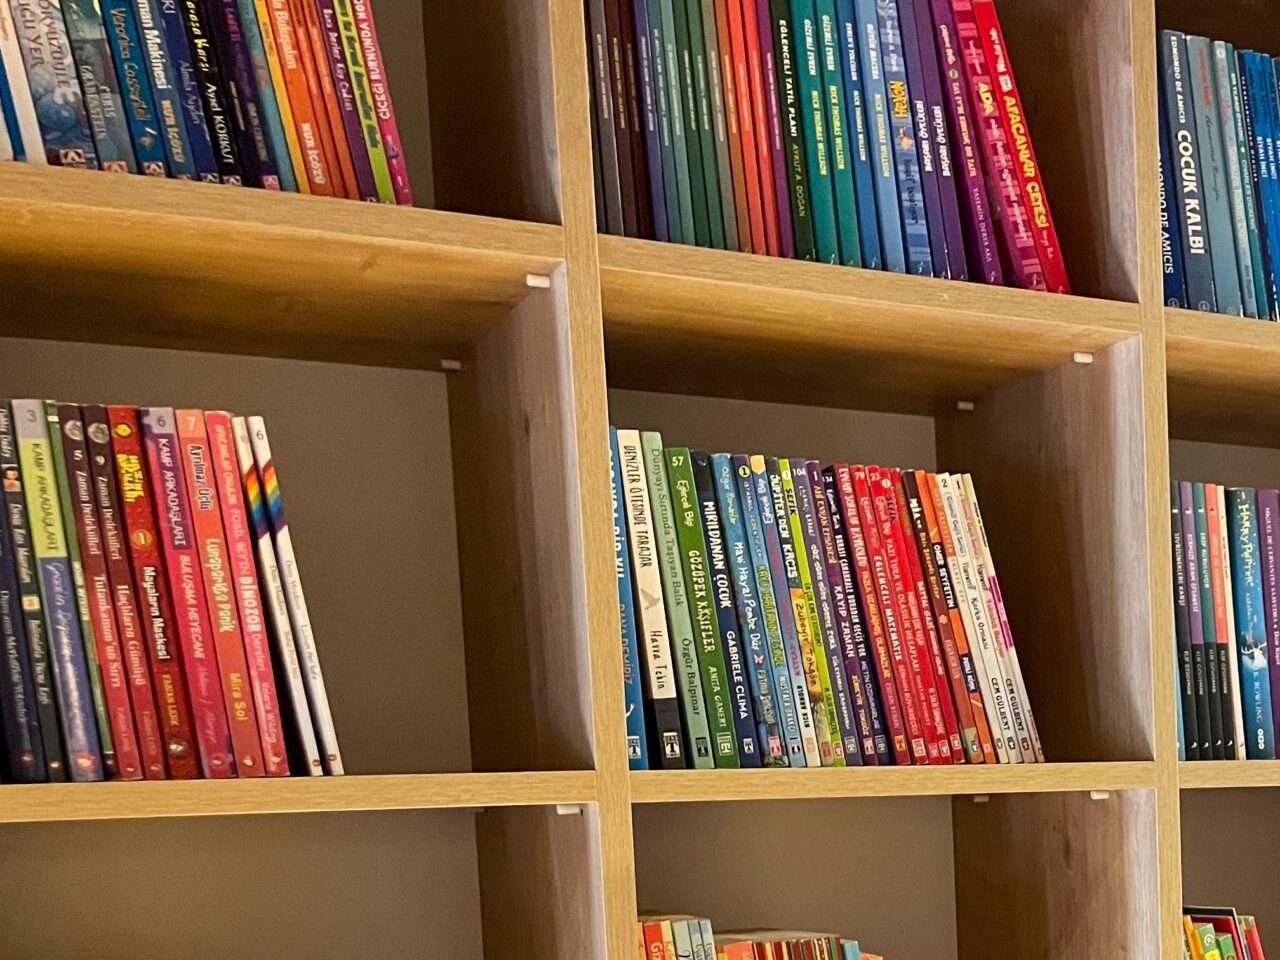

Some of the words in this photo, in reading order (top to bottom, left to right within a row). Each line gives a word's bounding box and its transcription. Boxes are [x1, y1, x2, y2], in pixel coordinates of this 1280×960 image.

[136, 0, 156, 27] man
[111, 8, 135, 58] Veronica
[143, 30, 171, 89] Makinesi
[1171, 36, 1182, 78] EDMONDO
[205, 83, 222, 111] Aysel
[784, 78, 796, 104] TATİL
[811, 90, 821, 108] NICK
[830, 86, 840, 103] NICK
[854, 90, 863, 105] NICK
[978, 82, 995, 116] ADA
[1175, 80, 1184, 92] DE
[875, 94, 885, 109] NICK
[1176, 94, 1187, 123] AMICIS
[787, 108, 798, 136] PLANI
[813, 110, 825, 141] THOMAS
[832, 106, 843, 135] THOMAS
[855, 108, 865, 132] THOMAS
[213, 115, 234, 163] KORKUT
[300, 123, 317, 148] NUR
[1003, 95, 1036, 177] AFACANLAR
[816, 143, 828, 174] WILLSON
[835, 137, 846, 169] WILLSON
[1185, 199, 1205, 254] KALBİ
[33, 443, 46, 472] KAMP
[159, 438, 174, 466] KAMP
[650, 448, 669, 491] Dünyayı
[75, 470, 92, 500] Zaman
[97, 476, 113, 506] Zaman
[81, 504, 101, 554] Dedektifleri
[657, 494, 675, 536] Sırtında
[1239, 504, 1254, 542] HARRY
[1264, 508, 1273, 534] MIGUEL
[102, 509, 122, 559] Dedektifleri
[635, 530, 655, 568] TARAJAR
[701, 502, 727, 569] MIRILDANAN
[1266, 536, 1274, 544] DE
[664, 540, 682, 579] Taşıyan
[733, 542, 749, 564] Mavi
[1267, 546, 1277, 585] CERVANTES
[142, 567, 163, 616] Mayaların
[670, 582, 686, 606] Balık
[713, 574, 733, 608] ÇOCUK
[737, 567, 755, 597] Hayal
[94, 574, 118, 658] Tutankamon'un
[742, 600, 760, 630] Pembe
[832, 586, 849, 617] KAYIP
[969, 598, 984, 619] Korku
[186, 607, 204, 658] HEYECANI
[217, 604, 236, 632] Panik
[150, 618, 170, 660] Maskesi
[651, 631, 666, 658] Havva
[681, 638, 698, 669] Özgür
[838, 621, 856, 658] ZAMAN
[726, 631, 743, 682] GABRIELE
[230, 673, 245, 698] Mira
[654, 665, 669, 690] Tekin
[708, 666, 722, 693] ANITA
[991, 678, 1003, 690] CEM
[1005, 678, 1017, 692] CEM
[259, 682, 275, 710] Valerie
[685, 672, 704, 716] Balpınar
[734, 686, 749, 719] CLIMA
[1254, 682, 1263, 722] ROWLING
[235, 701, 249, 720] Sol
[712, 695, 727, 726] GANERI
[994, 694, 1011, 730] GÜLBENT
[1008, 696, 1024, 732] GÜLBENT
[264, 713, 280, 742] Wilding
